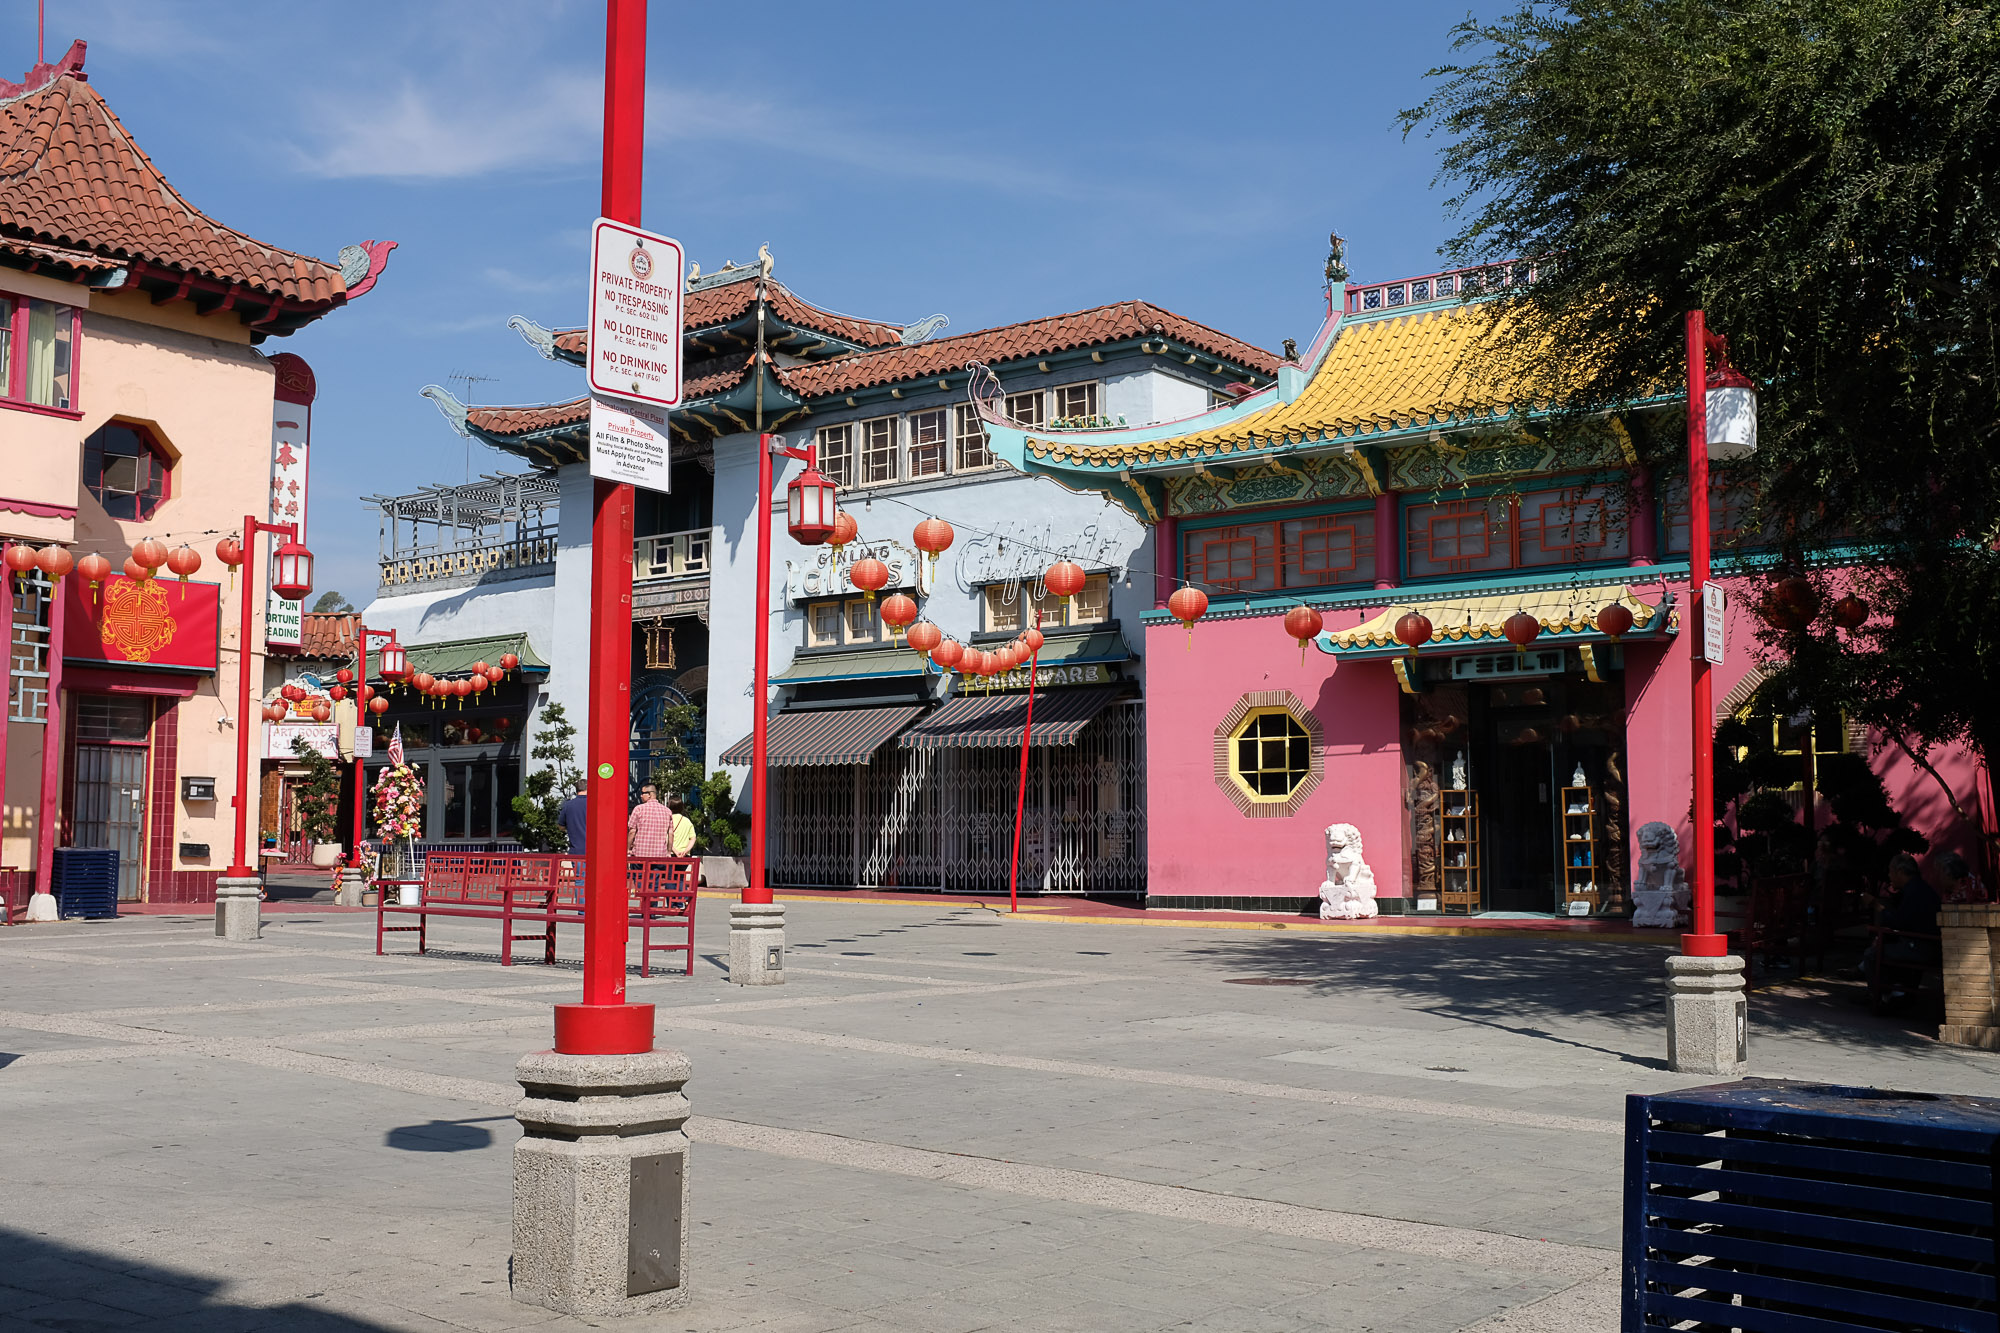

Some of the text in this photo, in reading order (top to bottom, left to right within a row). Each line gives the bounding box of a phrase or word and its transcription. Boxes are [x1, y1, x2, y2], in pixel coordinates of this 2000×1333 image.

[602, 271, 673, 300] PRIVATE PROPERTY
[605, 289, 669, 316] NO TRESPASSING
[616, 305, 625, 313] P.C.
[627, 308, 638, 316] SEC.
[639, 311, 650, 320] 602
[604, 319, 668, 344] NO LOITERING
[615, 335, 624, 343] P.C.
[626, 337, 637, 346] SEC.
[603, 350, 667, 374] NO DRINKING
[610, 365, 620, 373] P.C.
[621, 368, 632, 376] SEC.
[596, 400, 664, 424] Chinatown Central Plaza
[608, 422, 654, 440] Private Property
[606, 434, 619, 442] Film
[627, 438, 643, 448] Photo
[645, 443, 663, 453] Shoots
[597, 447, 610, 455] Must
[611, 450, 626, 459] Apply
[647, 458, 663, 467] Permit
[623, 461, 645, 471] Advance
[804, 561, 903, 594] GIFS
[280, 600, 298, 611] PUN
[266, 613, 299, 625] ORTUNE
[266, 627, 299, 638] EADING
[296, 665, 322, 674] CHEW
[273, 727, 334, 737] ART GOODS
[283, 740, 334, 750] JELRY
